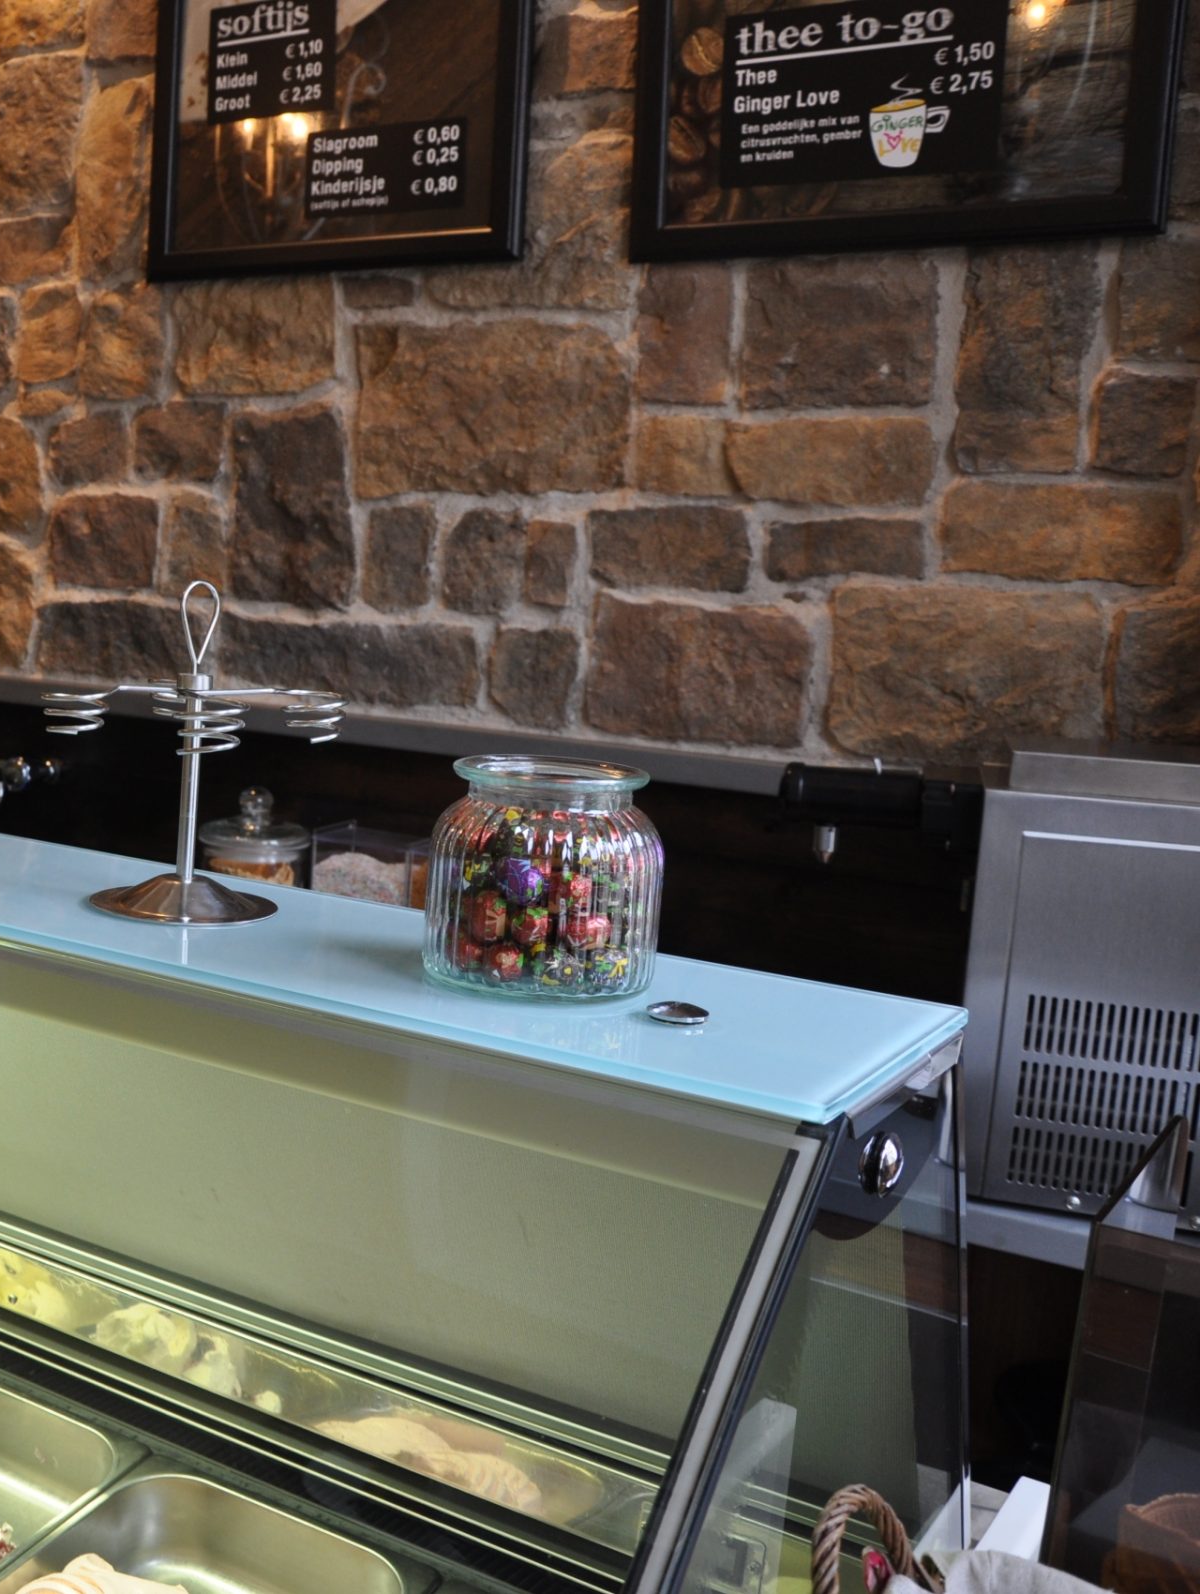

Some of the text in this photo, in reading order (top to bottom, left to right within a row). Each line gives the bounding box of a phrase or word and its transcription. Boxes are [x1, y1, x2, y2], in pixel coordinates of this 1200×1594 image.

[217, 1, 309, 38] softijs
[735, 7, 954, 55] thee to-go
[216, 38, 324, 69] Klein € 1,10
[735, 41, 996, 87] Thee € 1,50
[215, 61, 323, 91] Middel € 1,60
[215, 83, 322, 113] Groot € 2,25
[734, 69, 994, 115] Ginger Love € 2,75
[313, 124, 460, 155] Slagroom € 0,60
[740, 129, 863, 149] citrusvruchten, gember
[741, 115, 860, 135] Een goddelijke mix van
[312, 145, 459, 177] Dipping € 0,25
[740, 149, 794, 163] en kruiden
[311, 175, 458, 196] Kinderijsje € 0,80
